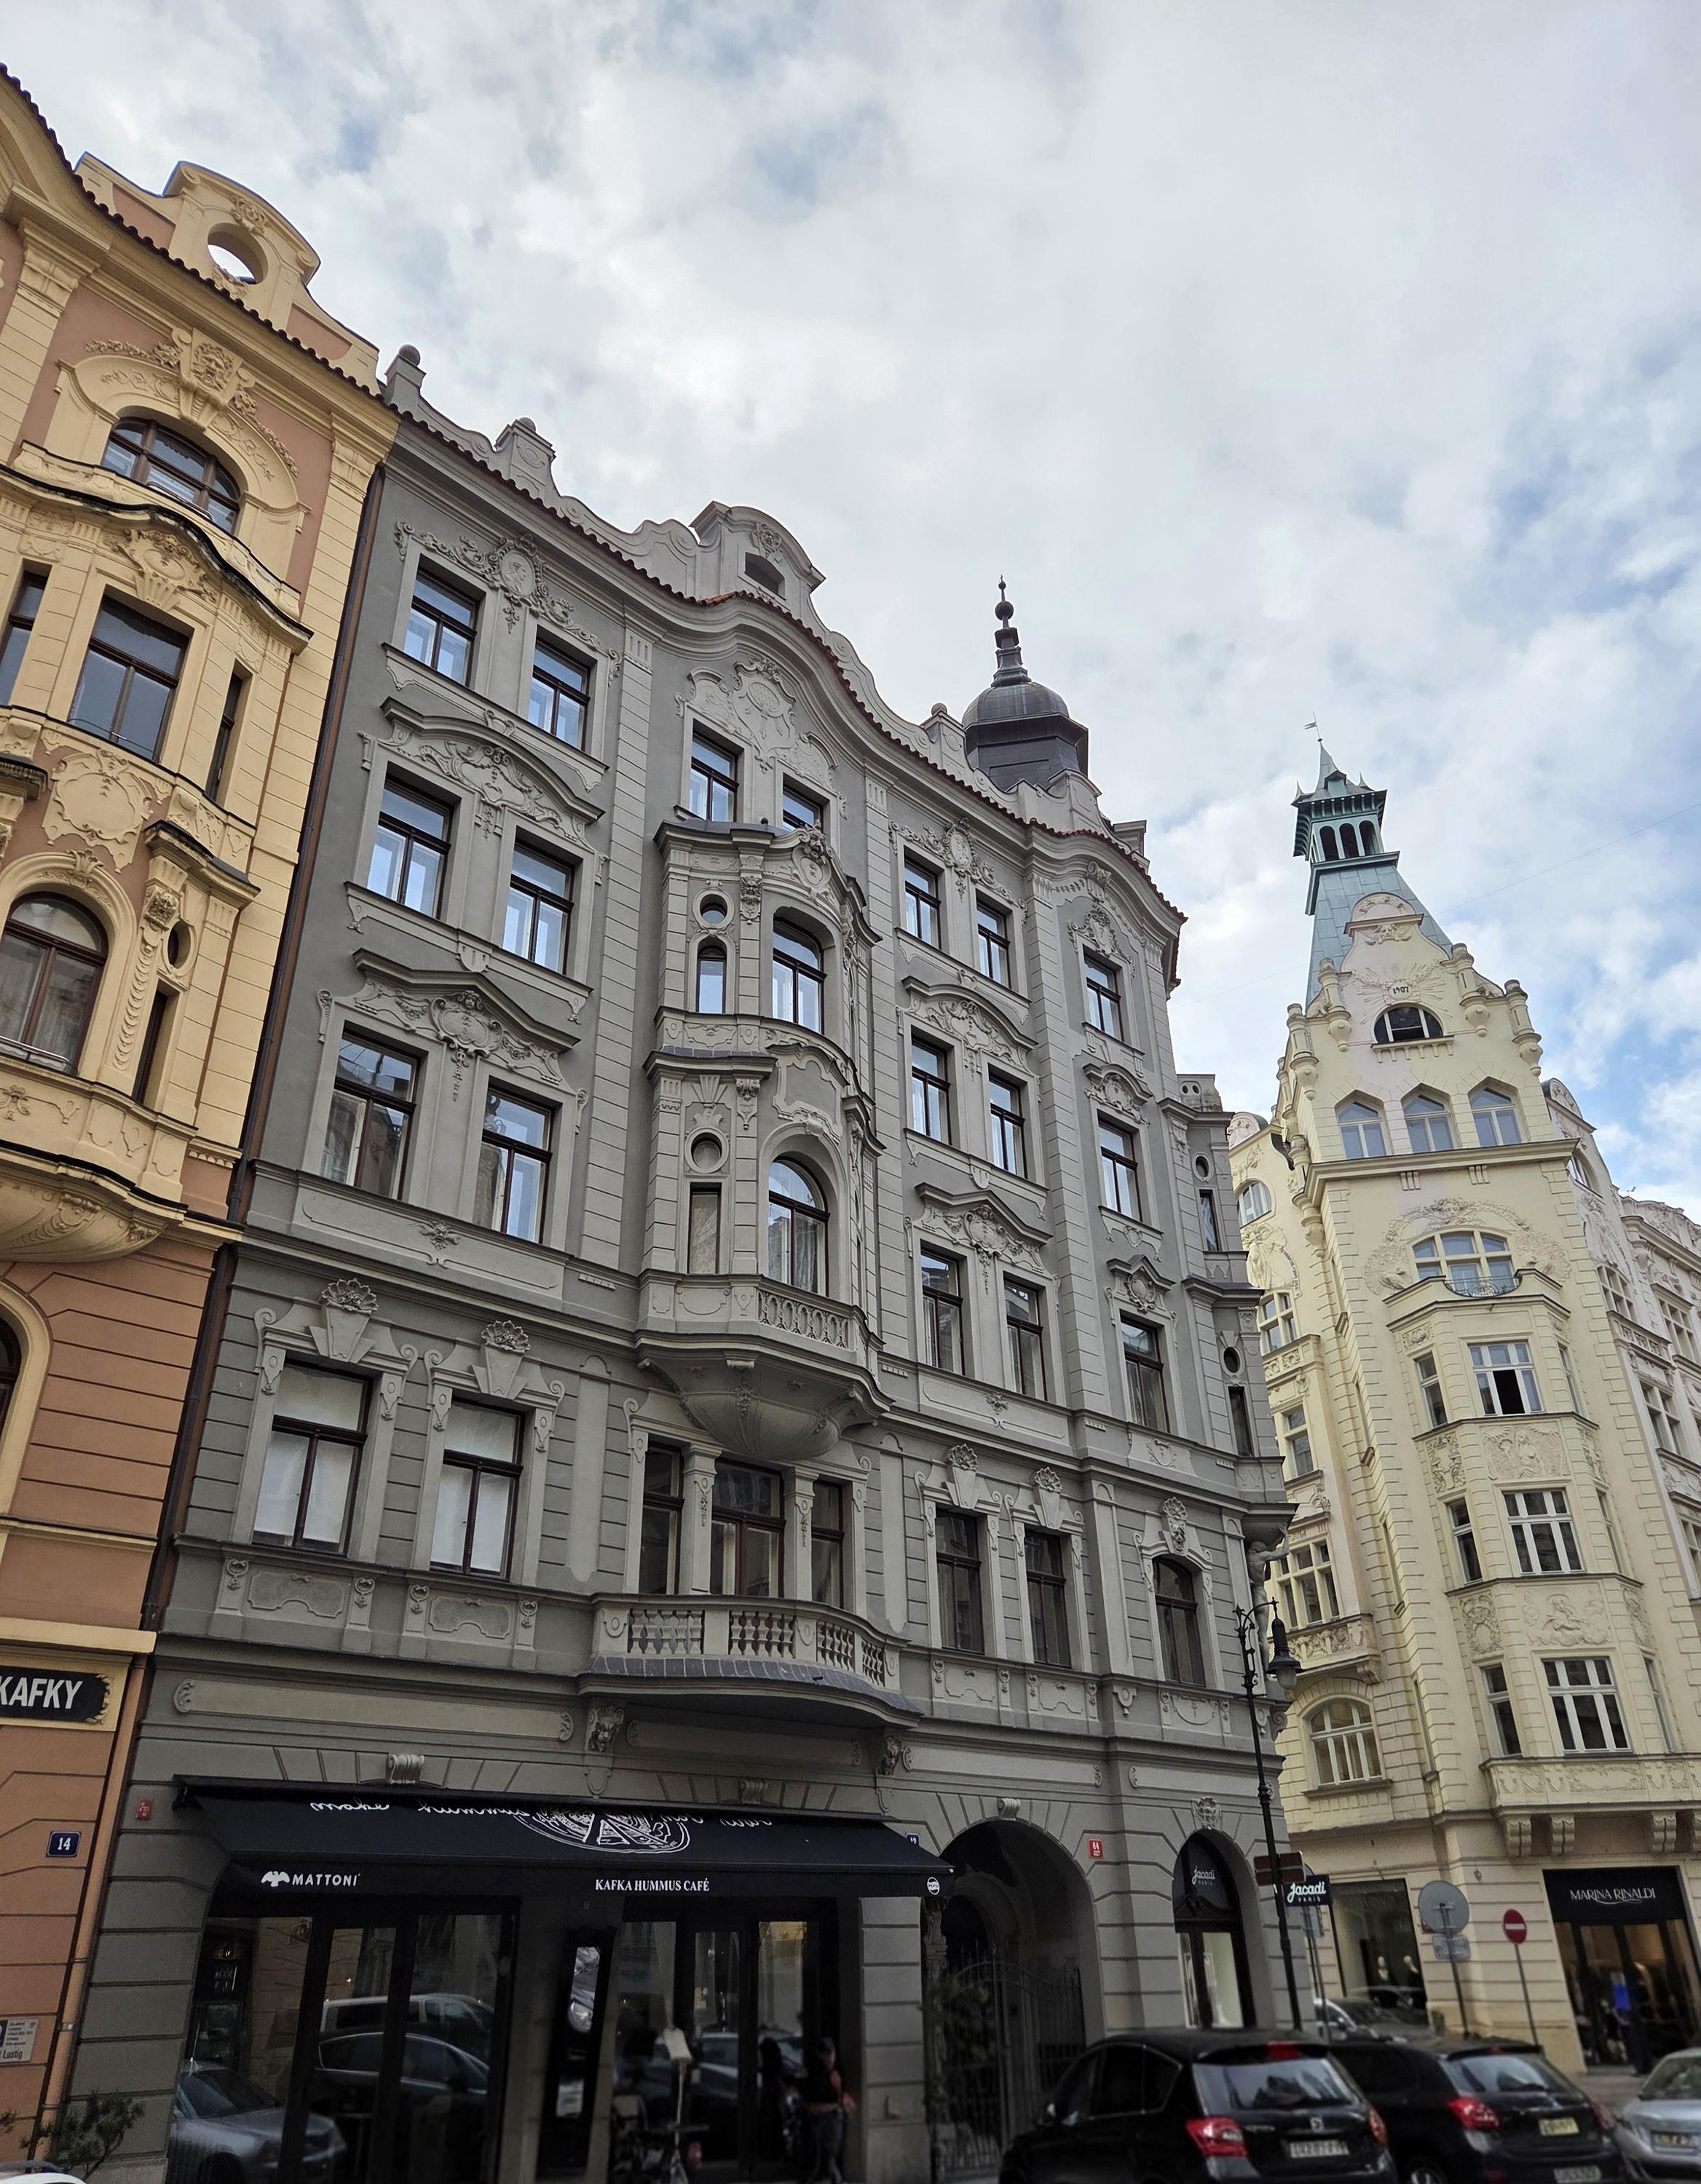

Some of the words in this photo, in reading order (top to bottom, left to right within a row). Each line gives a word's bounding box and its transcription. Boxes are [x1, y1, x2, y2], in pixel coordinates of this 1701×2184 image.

[1392, 986, 1409, 994] 1907
[0, 1676, 83, 1709] KAFKY
[58, 1837, 71, 1851] 14
[292, 1873, 358, 1887] MATTONI
[595, 1879, 633, 1891] KAFKA
[634, 1880, 682, 1891] HUMMUS
[683, 1878, 710, 1891] CAFÉ
[1569, 1888, 1614, 1902] MARINA
[1613, 1887, 1656, 1902] RINALDI
